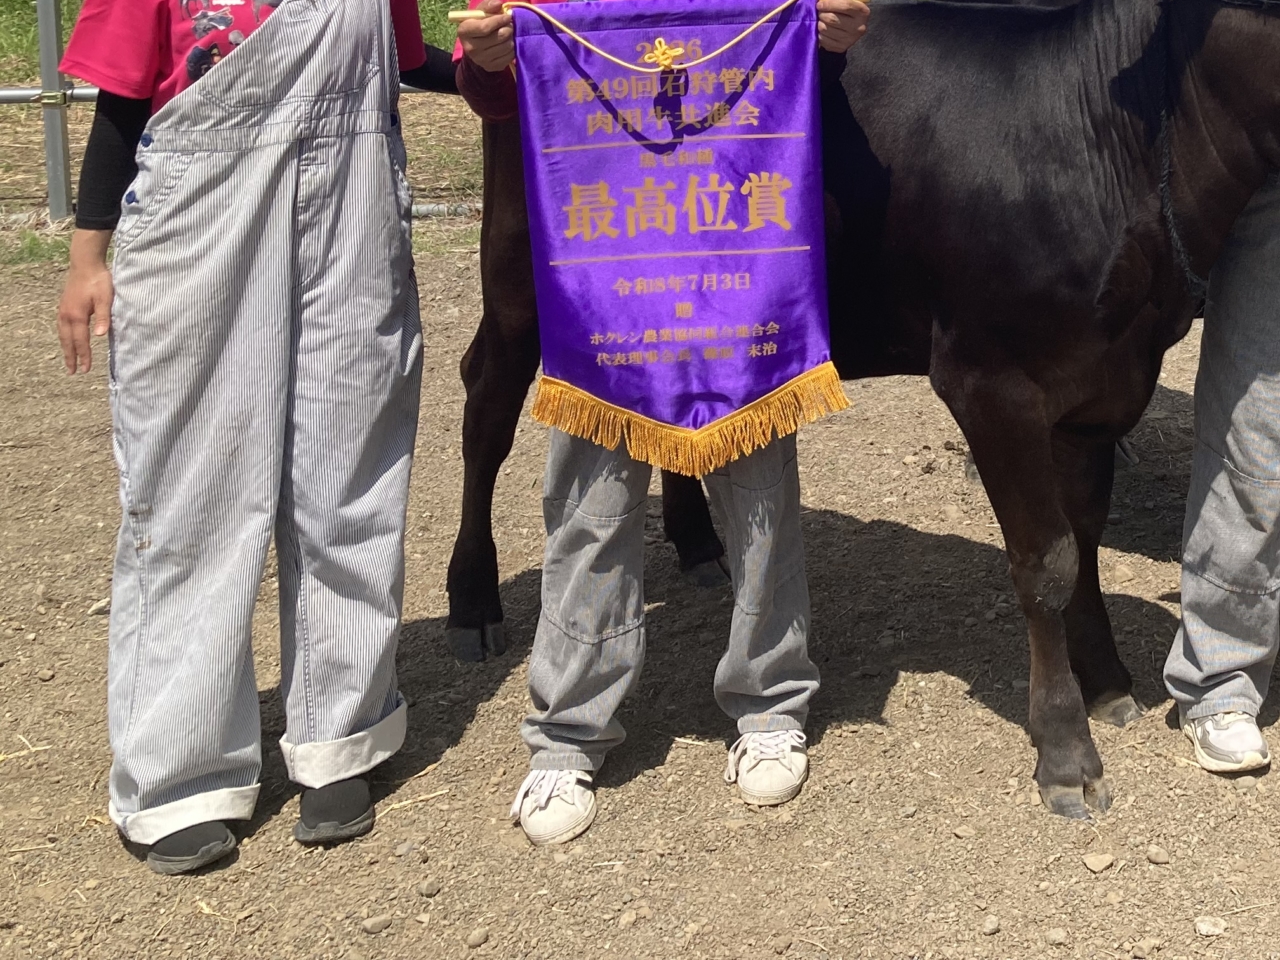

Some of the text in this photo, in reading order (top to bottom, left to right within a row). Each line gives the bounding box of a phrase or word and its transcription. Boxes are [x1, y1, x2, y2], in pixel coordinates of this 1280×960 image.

[566, 66, 775, 104] 第49回石狩管内
[587, 100, 761, 136] 肉用牛共進会
[562, 171, 793, 242] 最高位賞
[613, 272, 751, 297] 令和8年7月3日
